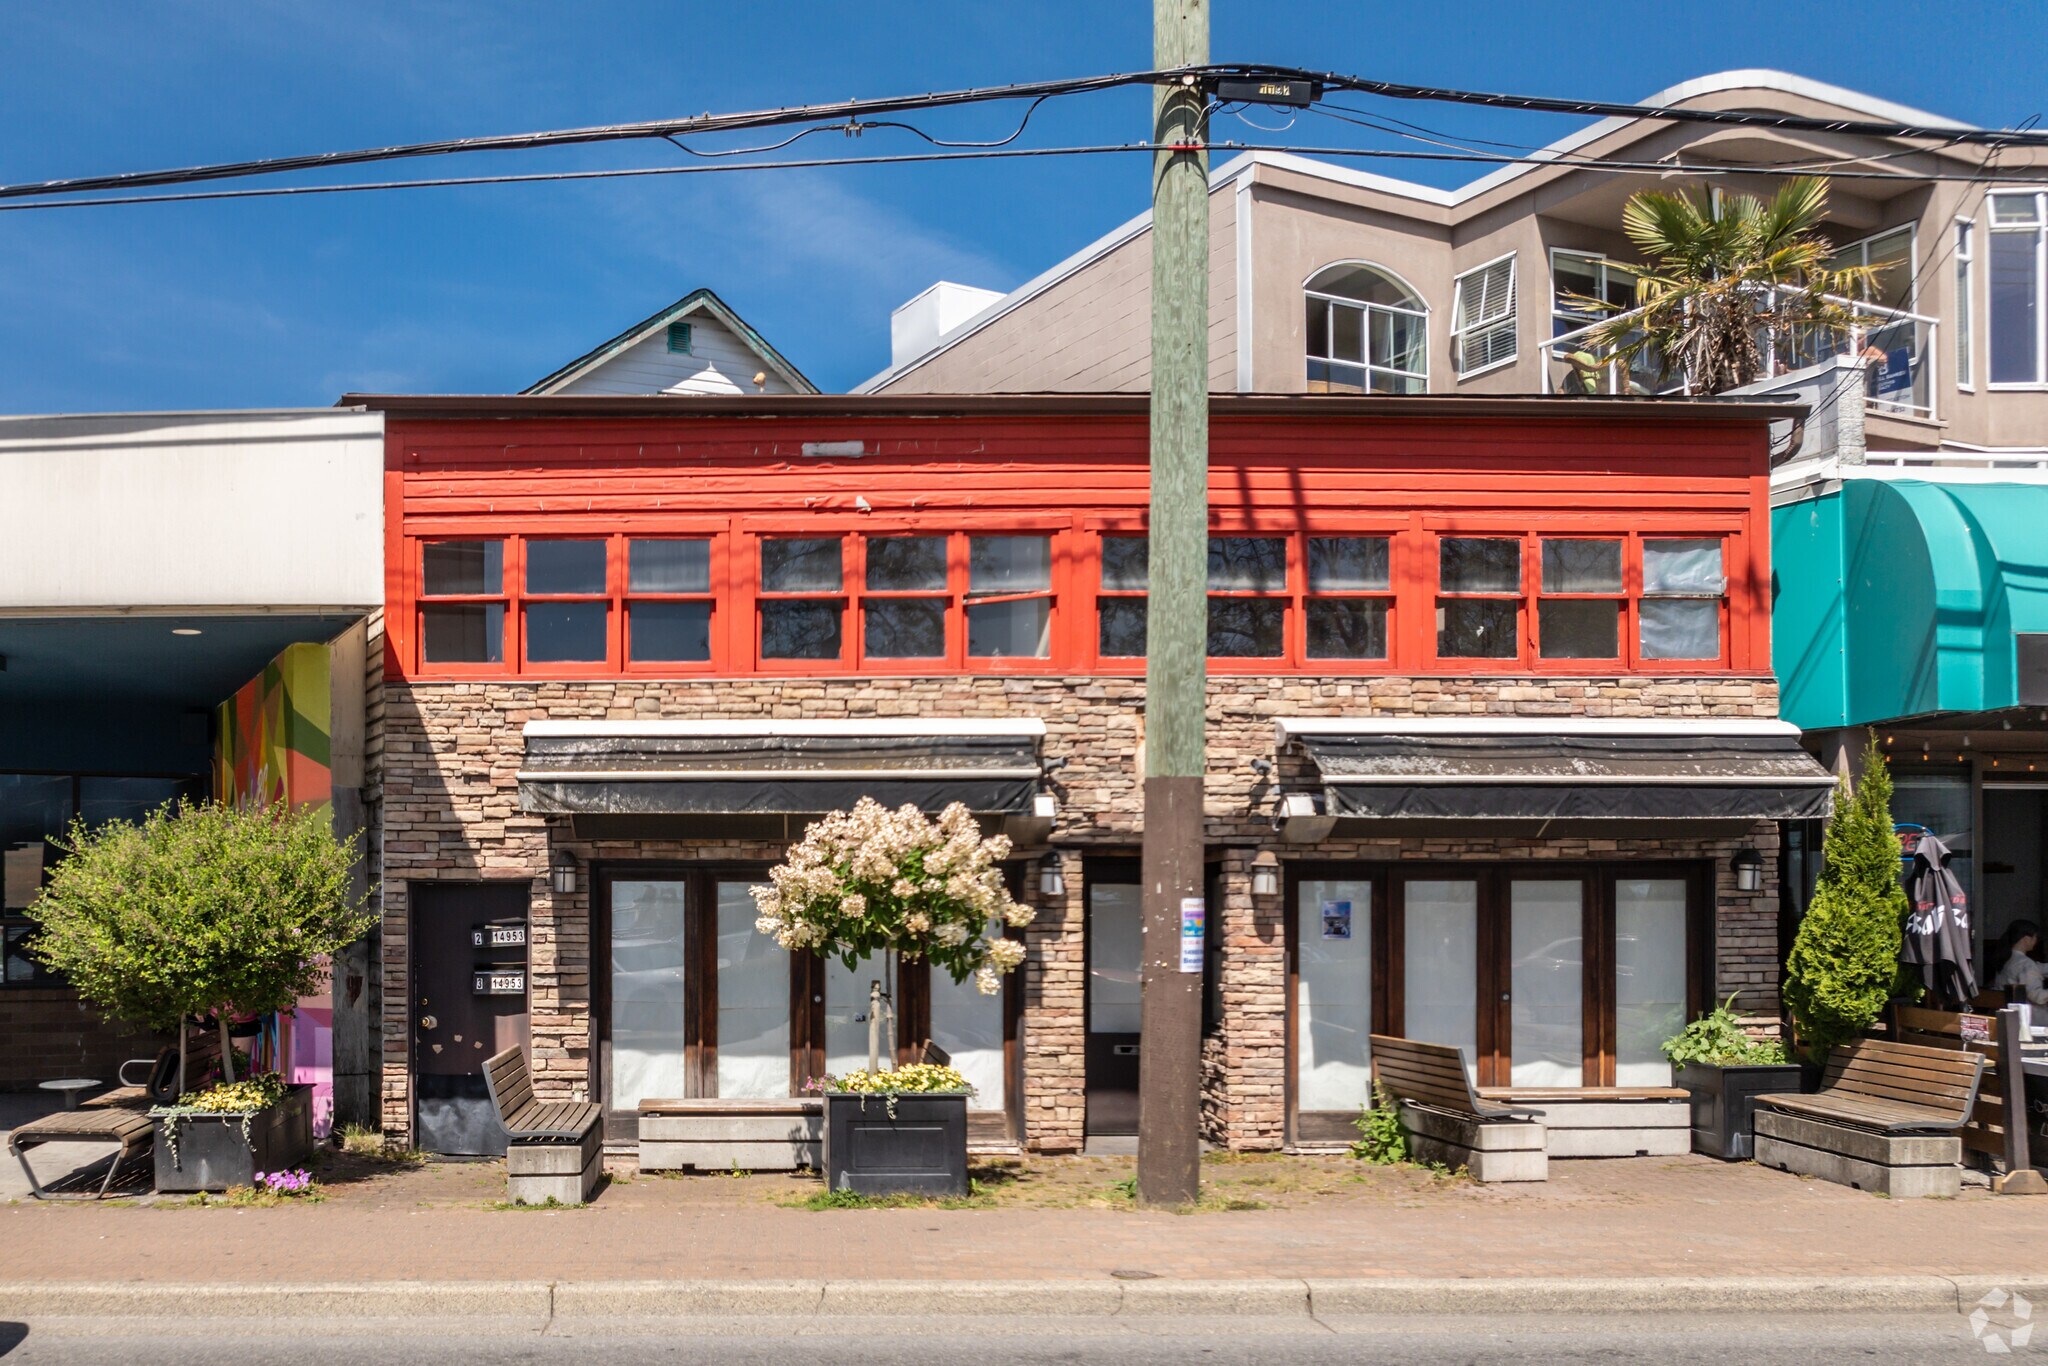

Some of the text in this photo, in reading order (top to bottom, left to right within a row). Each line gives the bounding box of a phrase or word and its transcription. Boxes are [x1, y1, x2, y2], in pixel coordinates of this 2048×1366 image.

[475, 931, 523, 944] 2 14953
[476, 978, 522, 989] 3 14953
